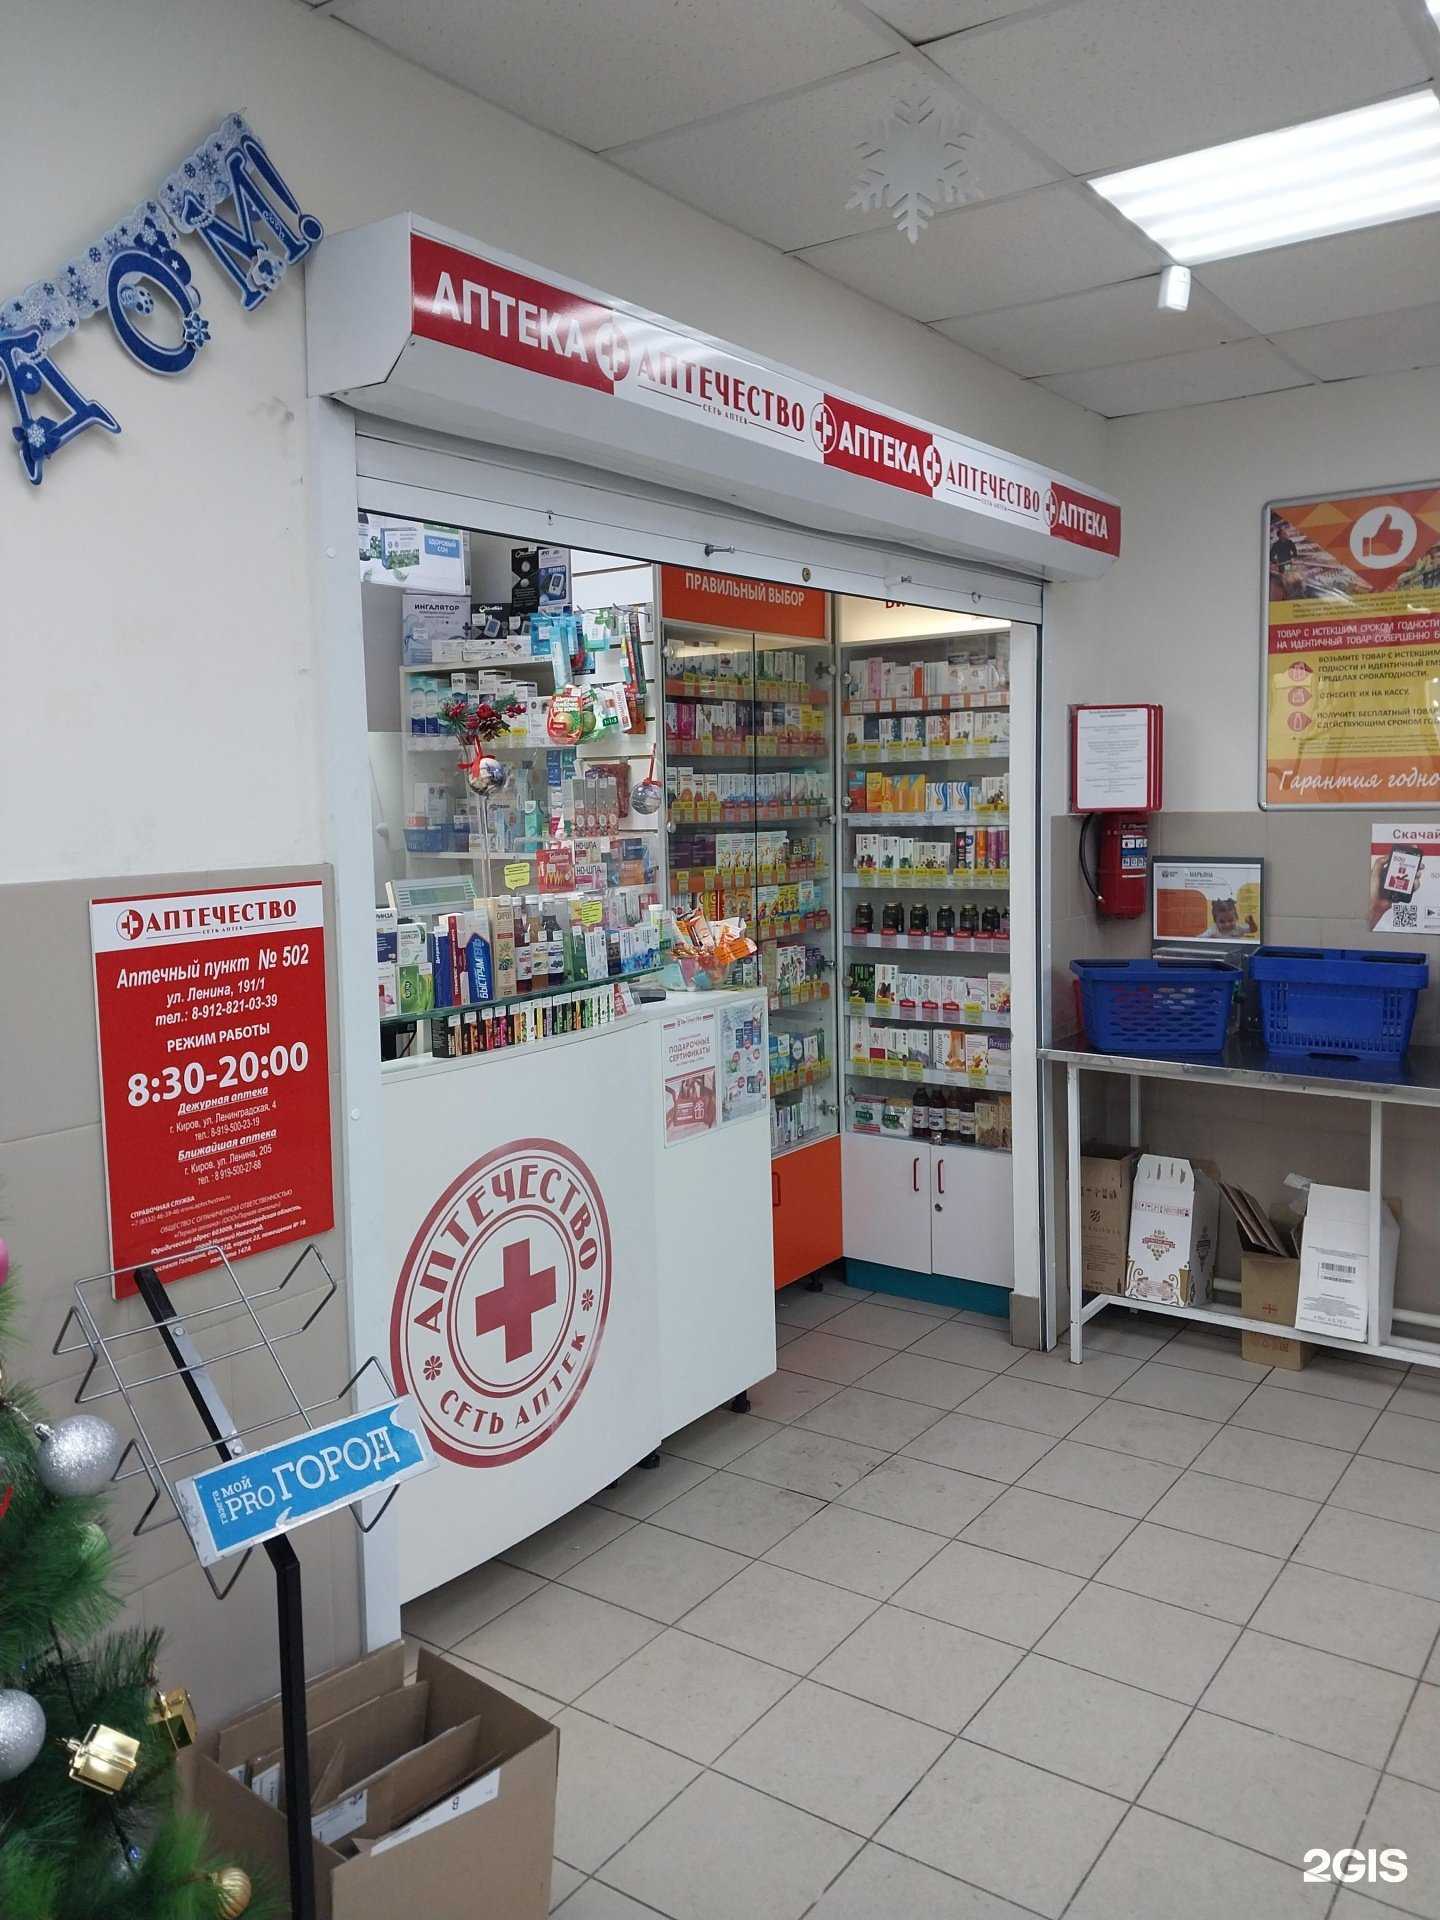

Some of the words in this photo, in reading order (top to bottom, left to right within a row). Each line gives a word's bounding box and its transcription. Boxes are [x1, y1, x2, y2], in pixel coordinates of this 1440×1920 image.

[431, 271, 589, 363] АПТЕКА
[637, 344, 805, 432] АПТЕЧЕСТВО
[838, 420, 921, 477] АПТЕКА
[946, 460, 1040, 513] АПТЕЧЕСТВО
[1057, 500, 1109, 540] АПТЕКА
[685, 571, 766, 602] ПРАВИЛЬНЫЙ
[768, 586, 805, 607] ВЫБОР
[414, 603, 460, 611] ИНГАЛЯТОР
[1276, 640, 1288, 649] НА
[1290, 636, 1343, 650] ИДЕНТИЧНЫЙ
[1346, 634, 1373, 645] ТОВАР
[1277, 629, 1299, 639] ТОВАР
[1312, 624, 1358, 637] ИСТЕКШИМ
[1279, 769, 1383, 791] Гарантия
[576, 840, 597, 849] НО-ШПА
[577, 864, 601, 875] НО-ШПА
[146, 899, 297, 933] АПТЕЧЕСТВО
[116, 958, 201, 989] Аптечный
[204, 956, 250, 981] пункт
[258, 949, 278, 970] №
[282, 943, 310, 967] 502
[166, 991, 184, 1008] ул.
[187, 985, 234, 1003] Ленина,
[238, 976, 266, 995] 191/1
[155, 1010, 189, 1027] тел.:
[191, 994, 278, 1020] 8-912-821-03-39
[167, 1033, 217, 1053] РЕЖИМ
[219, 1022, 271, 1044] РАБОТЫ
[668, 1036, 711, 1055] ПОДАРОЧНЫЕ
[668, 1045, 712, 1064] СЕРТИФИКАТЫ
[127, 1041, 309, 1107] 8:30-20:00
[177, 1096, 230, 1117] Дежурная
[231, 1086, 269, 1104] аптека
[215, 1103, 271, 1123] Ленинградская,
[272, 1100, 277, 1109] 4
[211, 1117, 260, 1138] 8-919-500-23-19
[178, 1139, 239, 1162] Ближайшая
[239, 1128, 277, 1146] аптека
[260, 1143, 272, 1156] 205
[130, 1202, 170, 1219] СПРАВОЧНАЯ
[170, 1195, 195, 1208] СЛУЖБА
[413, 1164, 598, 1334] АПТЕЧЕСТВО
[439, 1389, 505, 1435] СЕТЬ
[515, 1330, 588, 1430] АПТЕК
[272, 1425, 400, 1501] ГОРОД
